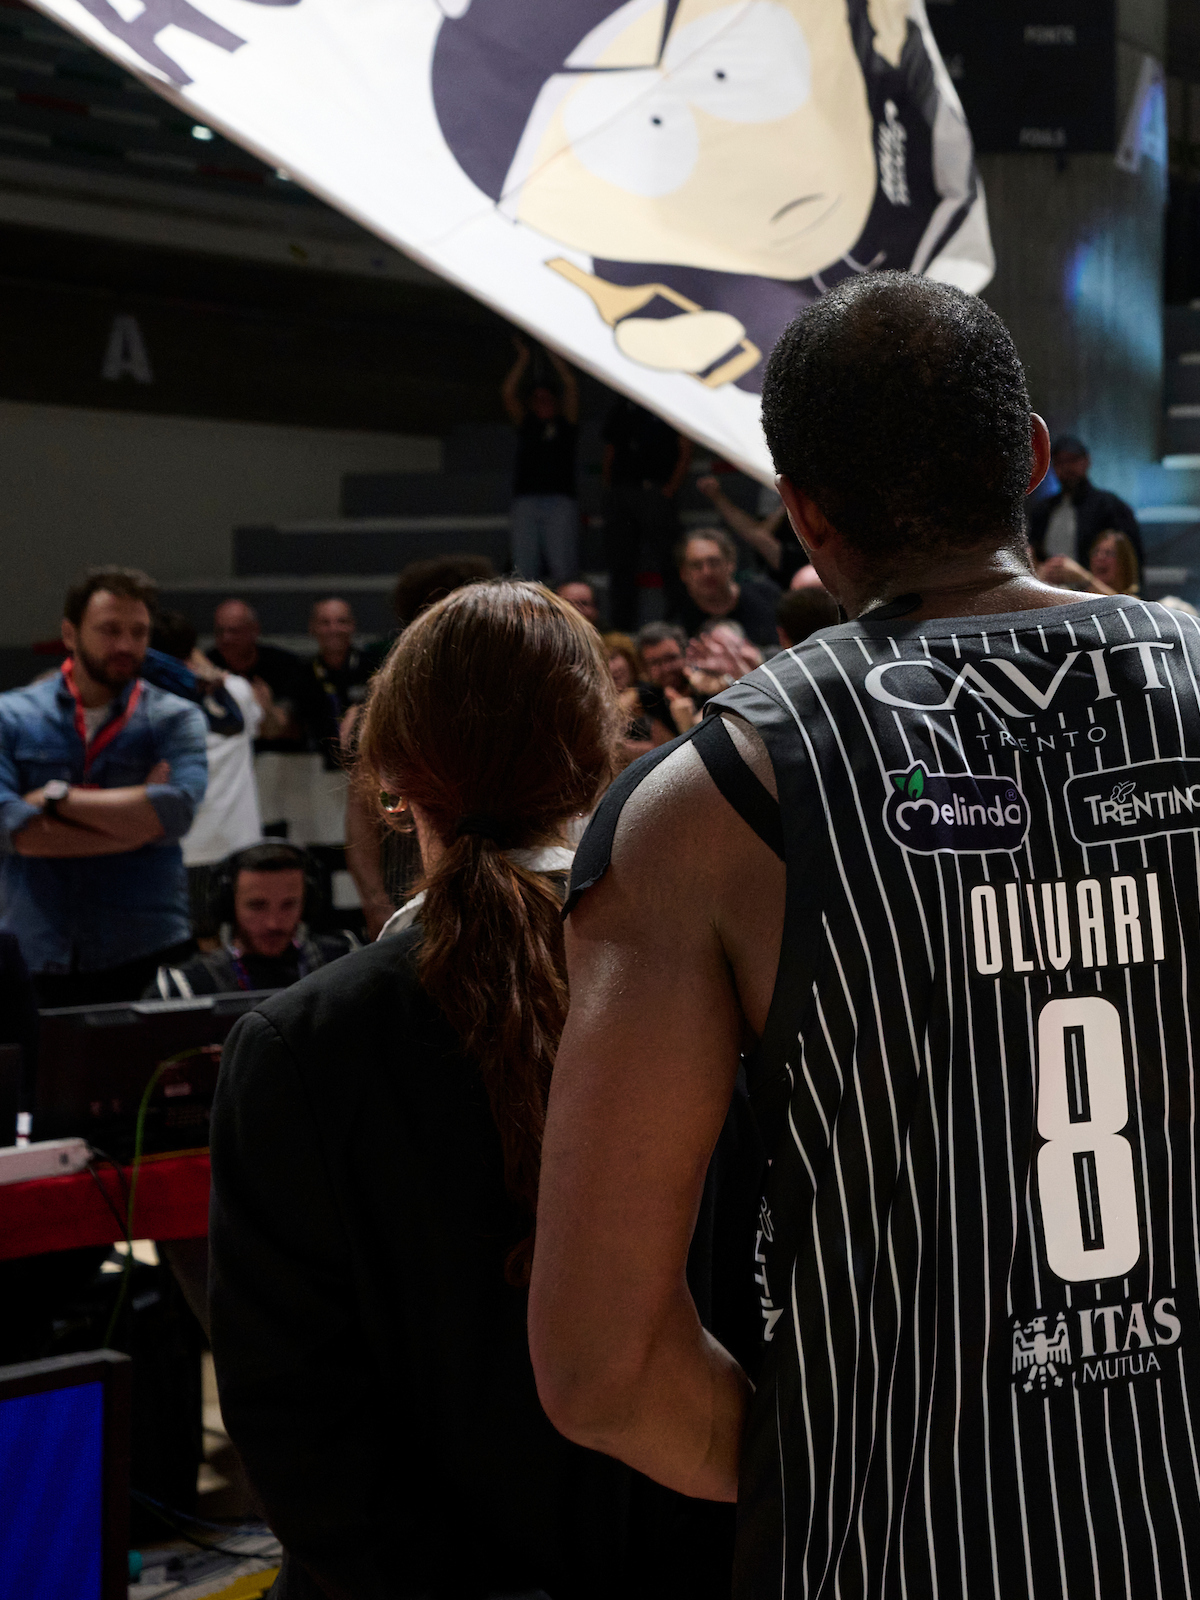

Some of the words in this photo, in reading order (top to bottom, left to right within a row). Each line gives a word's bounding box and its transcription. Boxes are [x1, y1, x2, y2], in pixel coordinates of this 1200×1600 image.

[101, 313, 154, 384] A
[865, 641, 1175, 719] CAVIT
[976, 726, 1107, 752] TRENTO
[896, 793, 1021, 831] Melinda
[1037, 995, 1143, 1283] 8
[1077, 1296, 1183, 1358] ITAS
[1082, 1351, 1162, 1384] MUTUA
